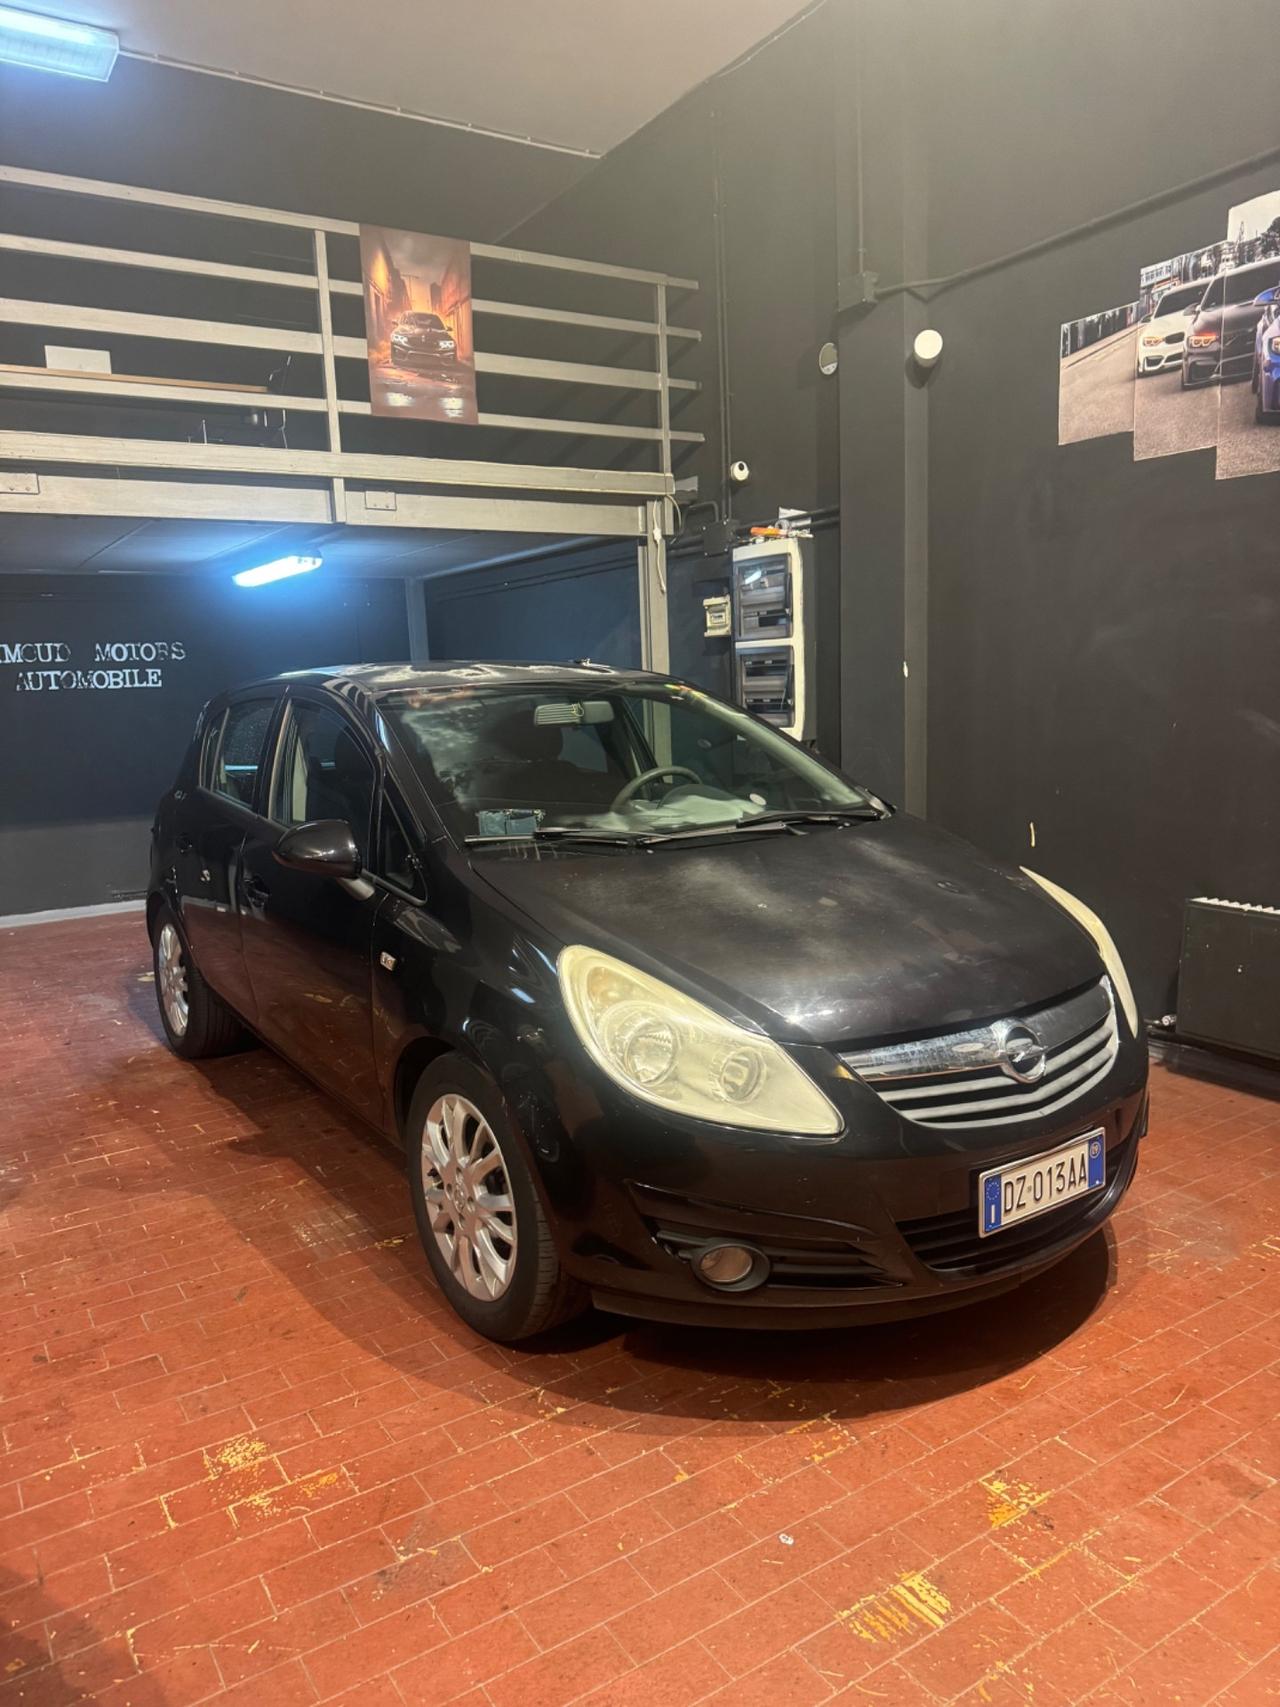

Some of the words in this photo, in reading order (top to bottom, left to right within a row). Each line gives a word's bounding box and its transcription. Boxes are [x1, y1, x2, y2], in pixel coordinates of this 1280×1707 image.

[0, 642, 72, 664] MOUD
[94, 642, 187, 662] MOTORS
[16, 668, 163, 692] AUTOMOBILE
